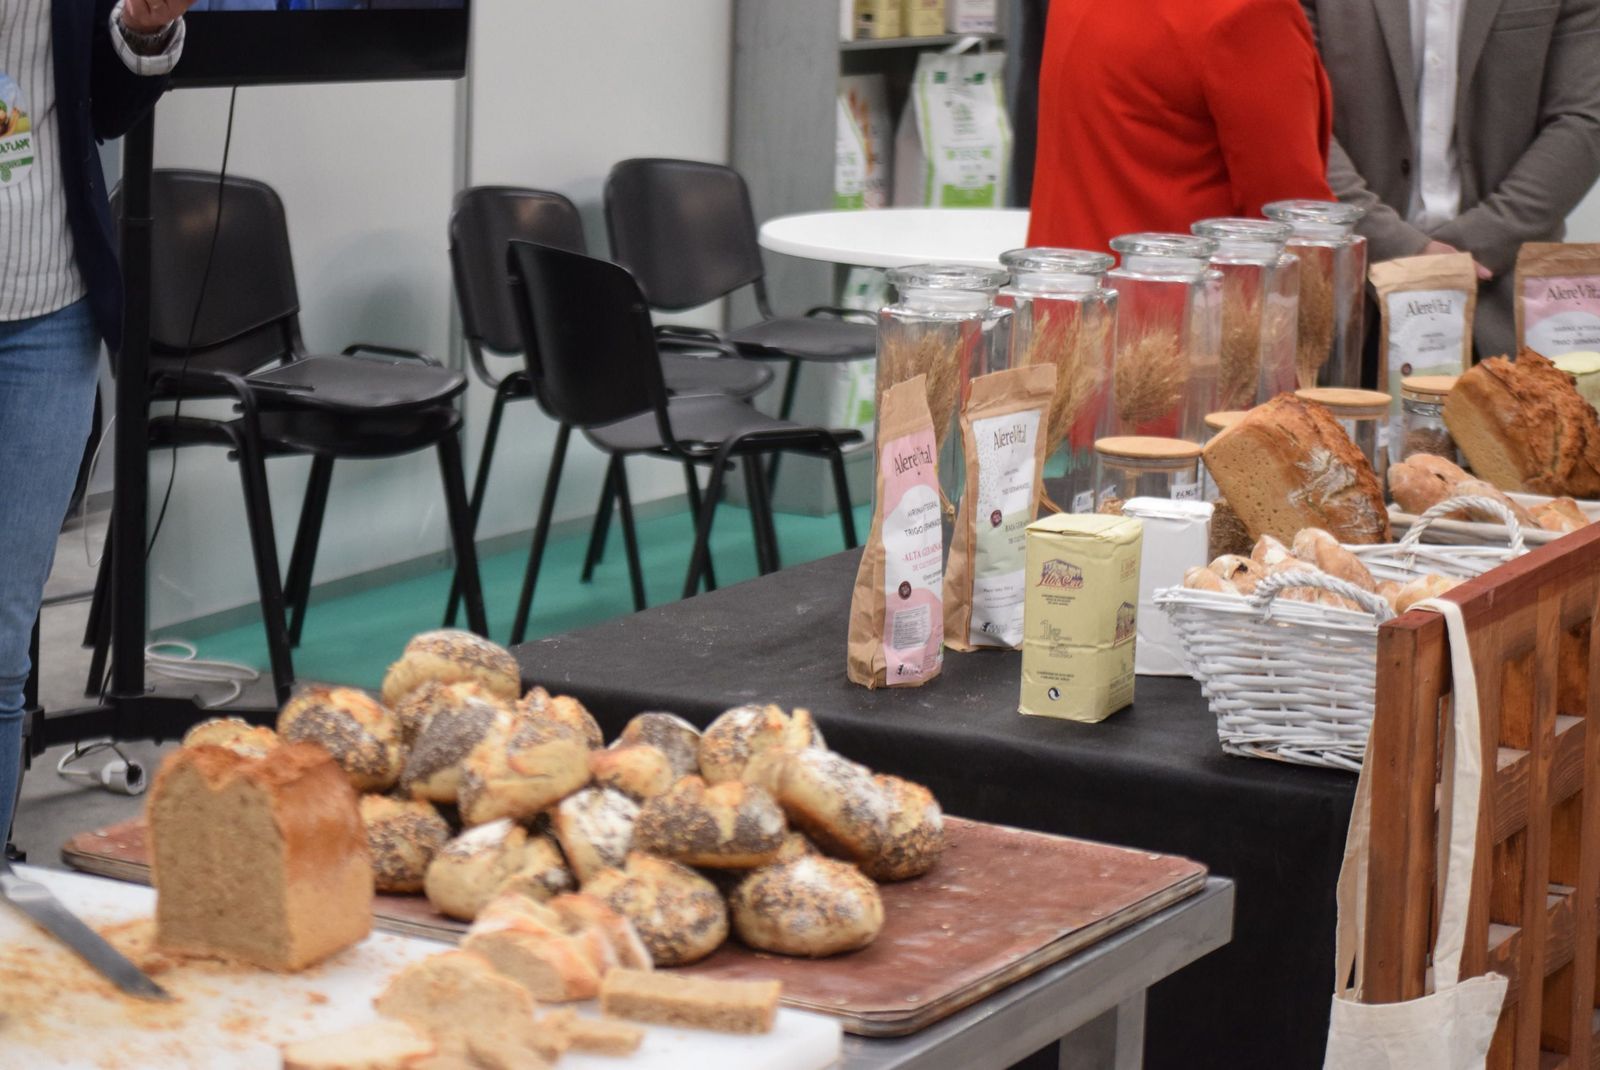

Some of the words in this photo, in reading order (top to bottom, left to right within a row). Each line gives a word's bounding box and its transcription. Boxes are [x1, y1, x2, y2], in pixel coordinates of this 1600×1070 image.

[994, 424, 1027, 451] AlereVital
[894, 444, 932, 477] AlereVital
[904, 525, 924, 537] TRIGO
